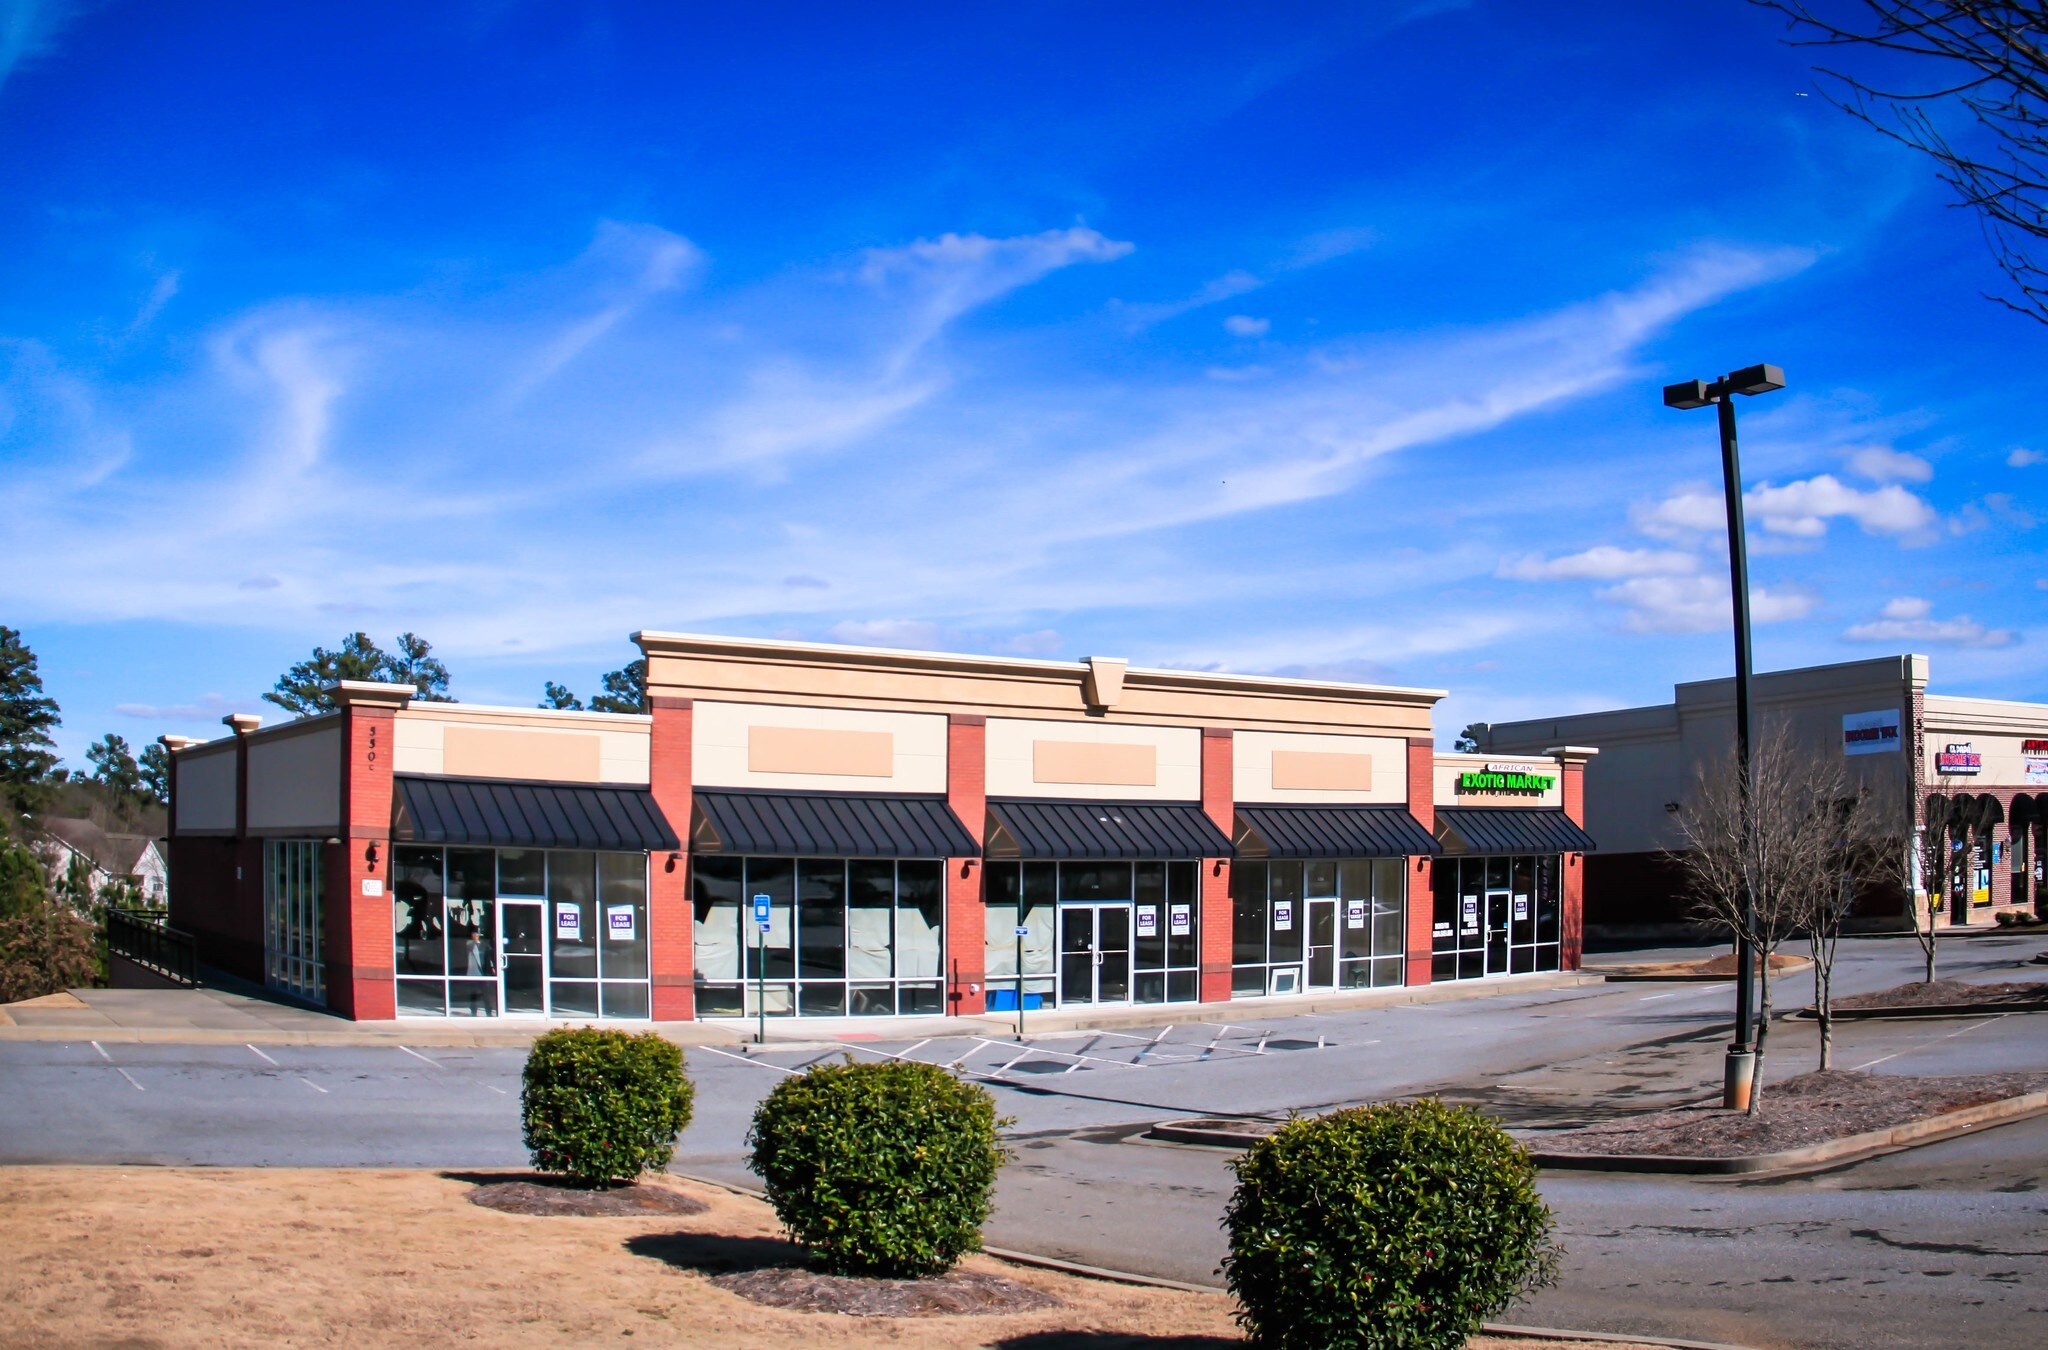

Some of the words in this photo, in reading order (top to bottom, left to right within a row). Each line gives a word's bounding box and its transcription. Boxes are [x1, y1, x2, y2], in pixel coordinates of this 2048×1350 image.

[1940, 753, 1967, 766] INCOME
[1967, 753, 1982, 766] TAX
[1491, 764, 1534, 772] AFRICAN
[1462, 773, 1505, 788] EXOTIC
[1506, 774, 1556, 790] MARKET
